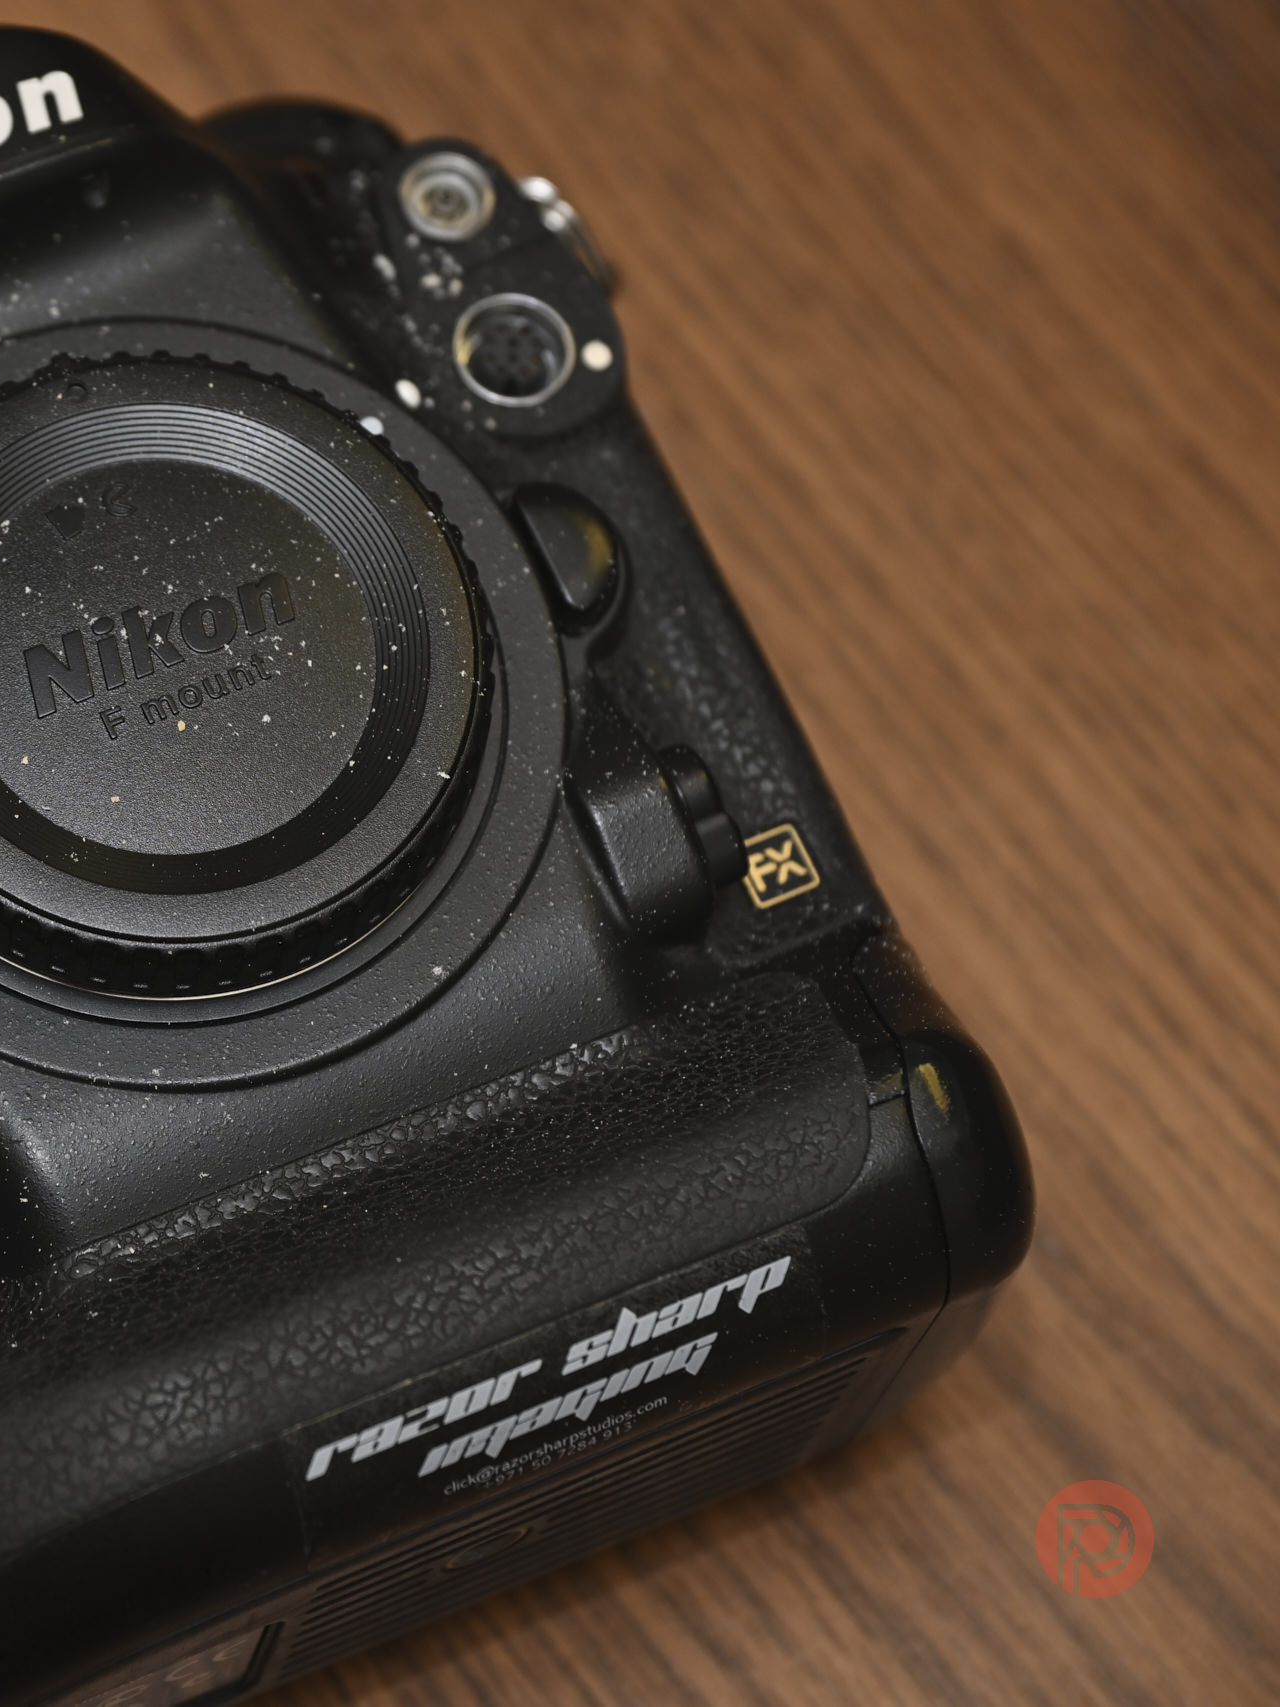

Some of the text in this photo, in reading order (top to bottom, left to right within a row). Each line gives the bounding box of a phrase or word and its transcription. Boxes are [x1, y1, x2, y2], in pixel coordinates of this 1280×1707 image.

[23, 573, 296, 719] Nikon
[99, 653, 273, 740] F mount
[748, 840, 808, 892] FX
[306, 1256, 791, 1481] razor sharp
[443, 1395, 669, 1496] click@razorsharpstudios.com
